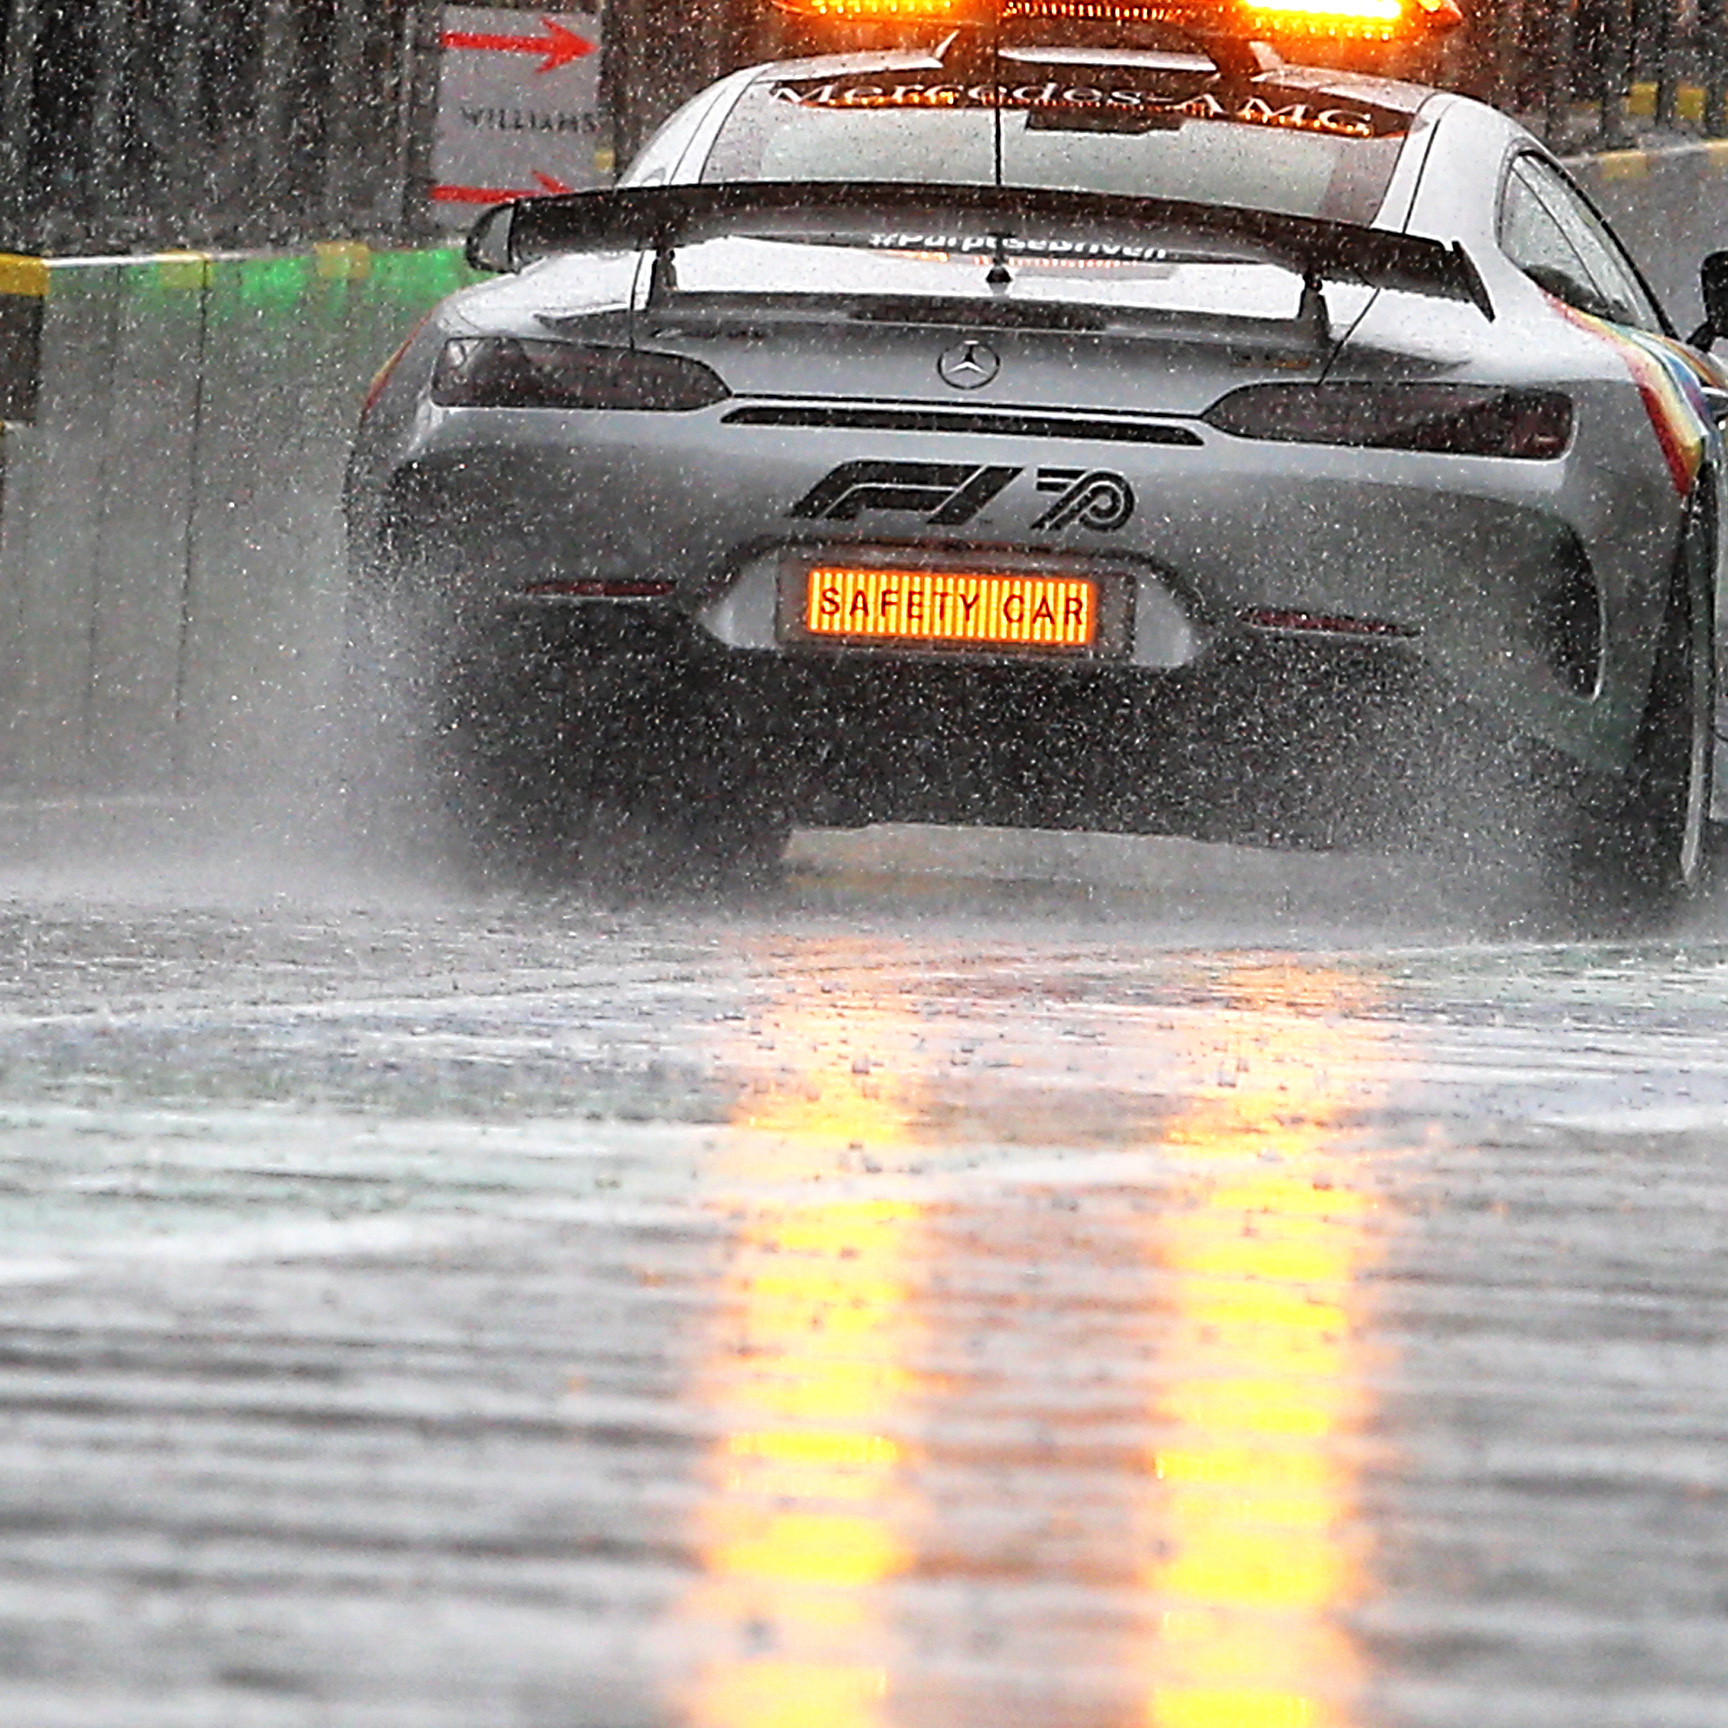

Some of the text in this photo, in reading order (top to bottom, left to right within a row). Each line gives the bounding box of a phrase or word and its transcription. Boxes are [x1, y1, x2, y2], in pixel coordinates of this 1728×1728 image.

[768, 81, 1372, 136] Mercedes-AMG
[819, 585, 1085, 625] SAFETY CAR
